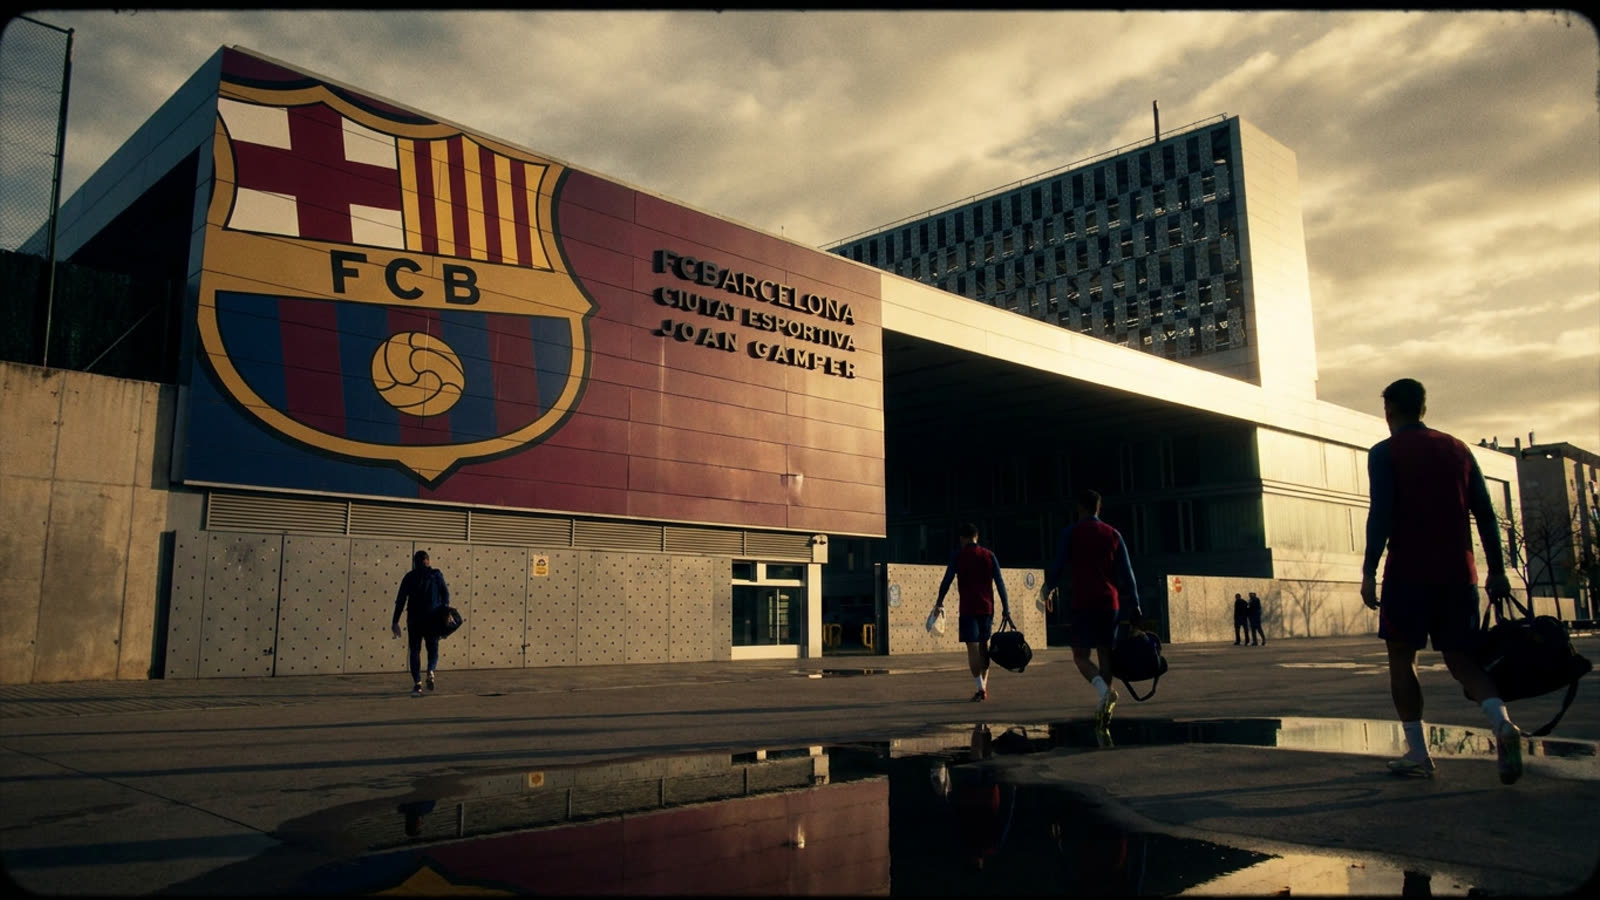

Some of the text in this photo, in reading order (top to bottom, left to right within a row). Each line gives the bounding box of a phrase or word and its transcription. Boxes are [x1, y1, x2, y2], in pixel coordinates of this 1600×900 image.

[653, 286, 855, 352] CIUTAT ESPORTIVA
[653, 318, 856, 378] JOAN GAMPER
